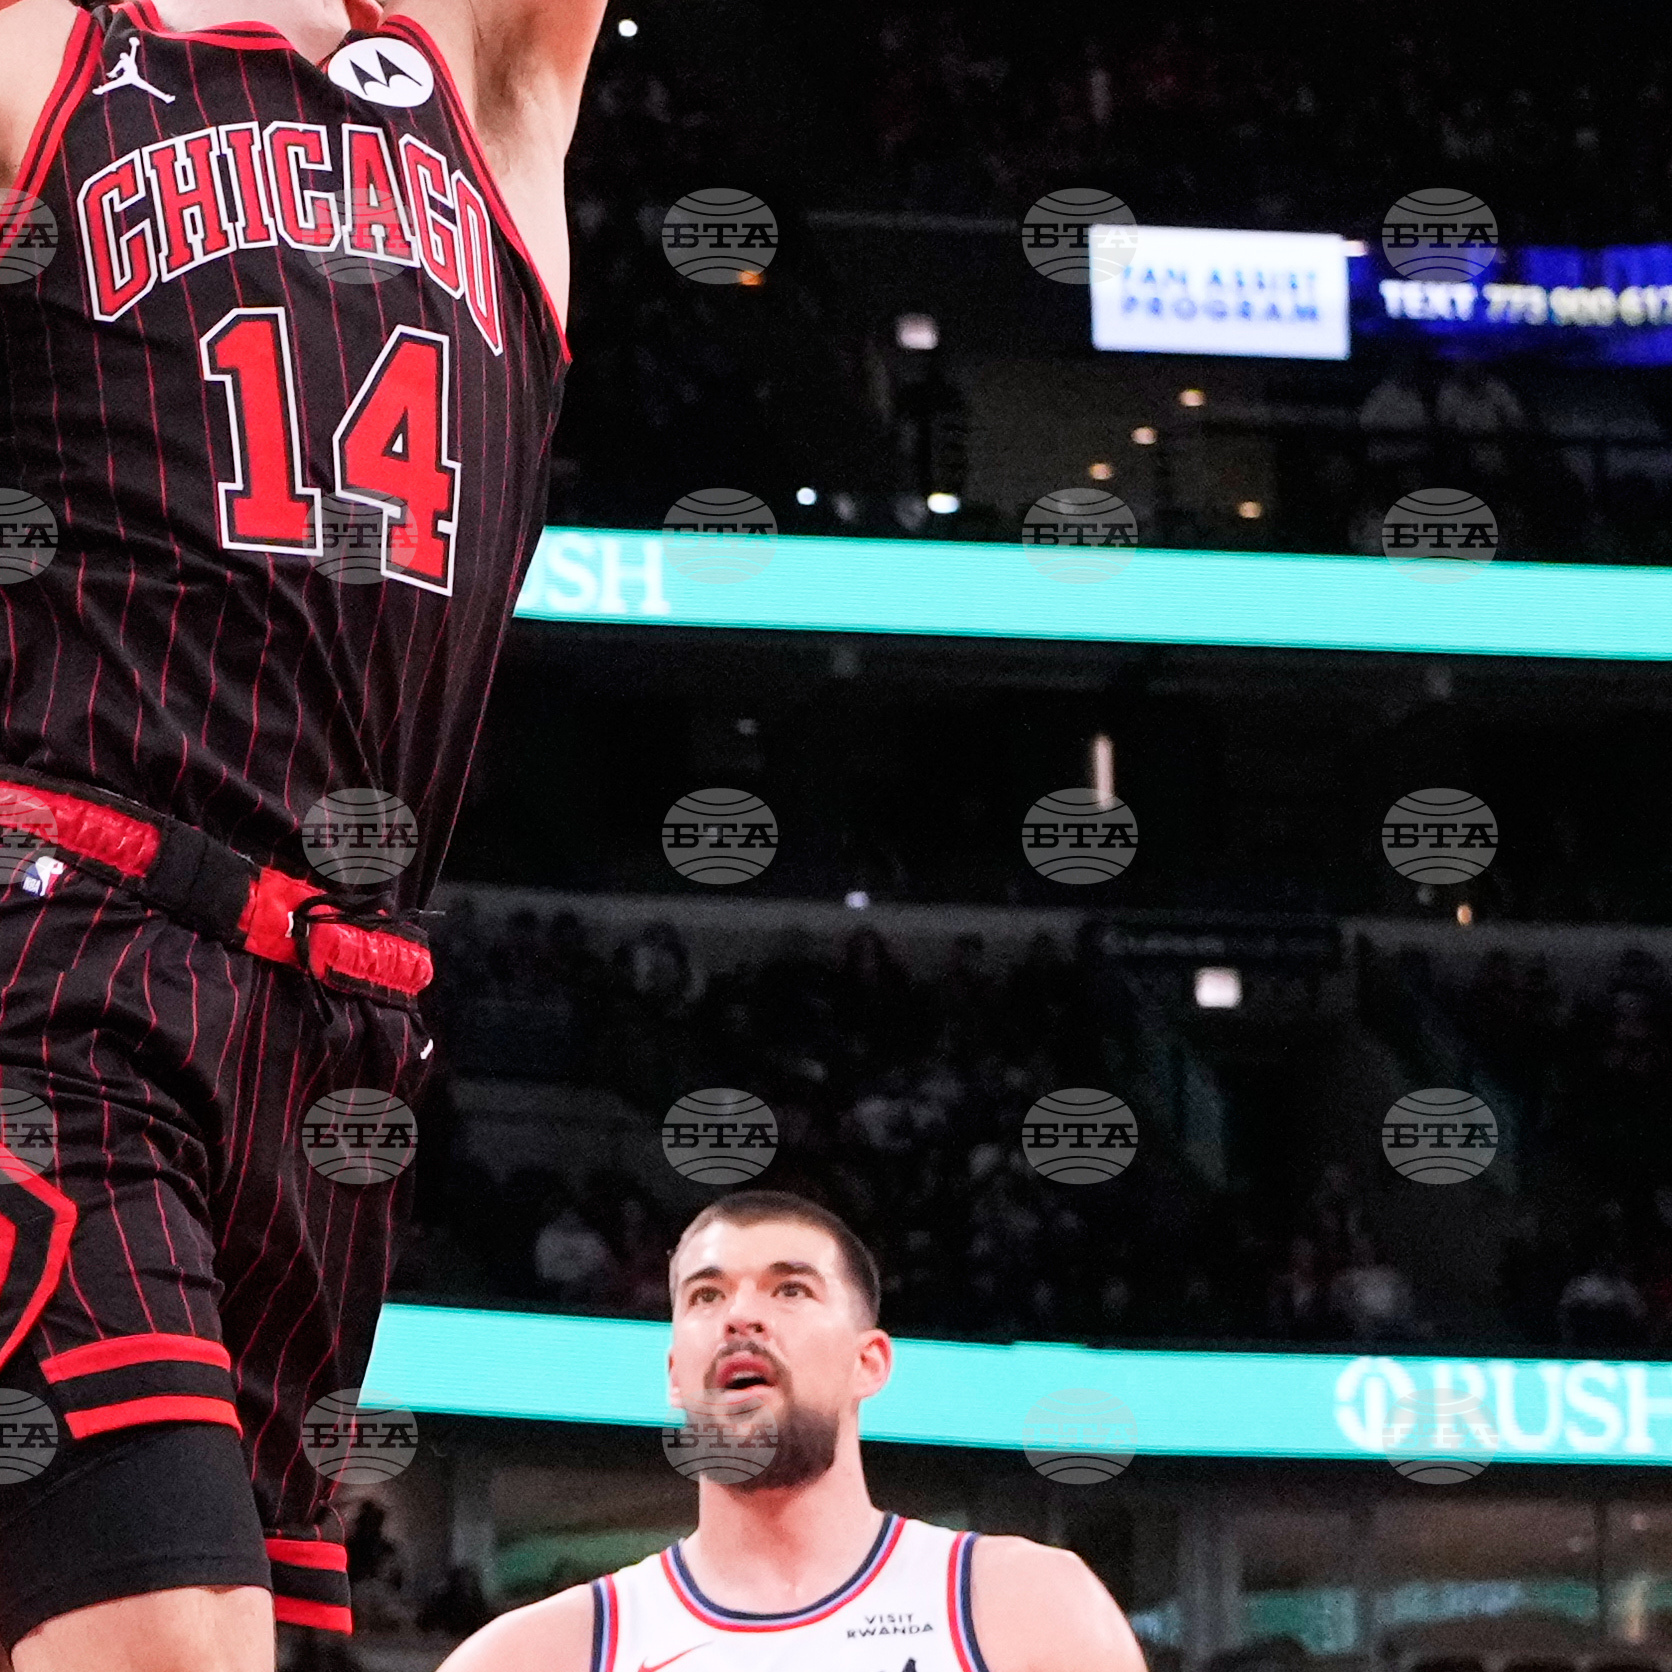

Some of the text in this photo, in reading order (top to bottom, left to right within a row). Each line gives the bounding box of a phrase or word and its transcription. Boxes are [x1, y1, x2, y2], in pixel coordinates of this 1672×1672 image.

[77, 121, 503, 356] CHICAGO
[199, 307, 462, 597] 14
[846, 1623, 934, 1639] RWANDA
[865, 1613, 913, 1625] VISIT
